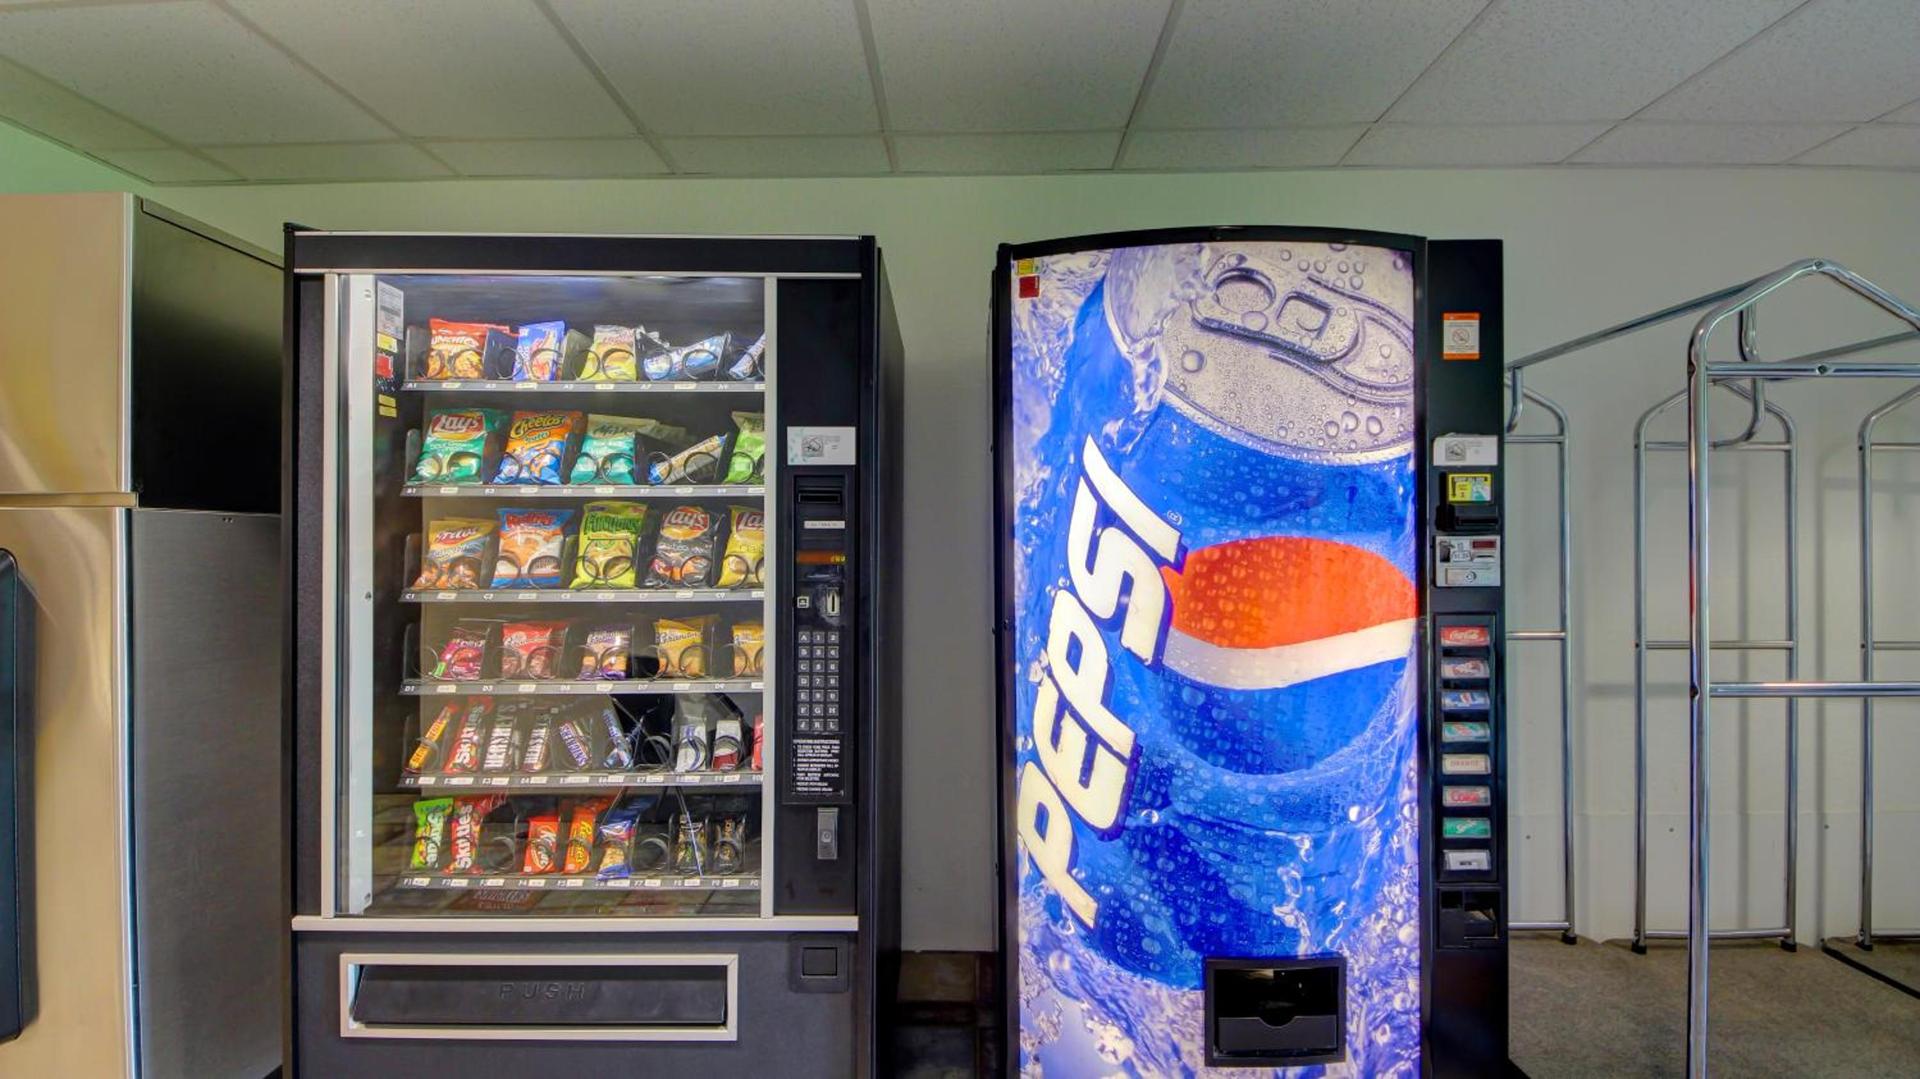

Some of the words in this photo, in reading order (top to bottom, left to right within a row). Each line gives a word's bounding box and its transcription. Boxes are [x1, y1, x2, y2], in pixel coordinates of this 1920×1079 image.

[436, 414, 479, 432] Lay's
[510, 415, 565, 439] Cheetos
[662, 510, 705, 527] Lay's
[1017, 433, 1184, 930] PEPSI
[455, 804, 473, 869] Skittles
[500, 982, 586, 1000] PUSH
